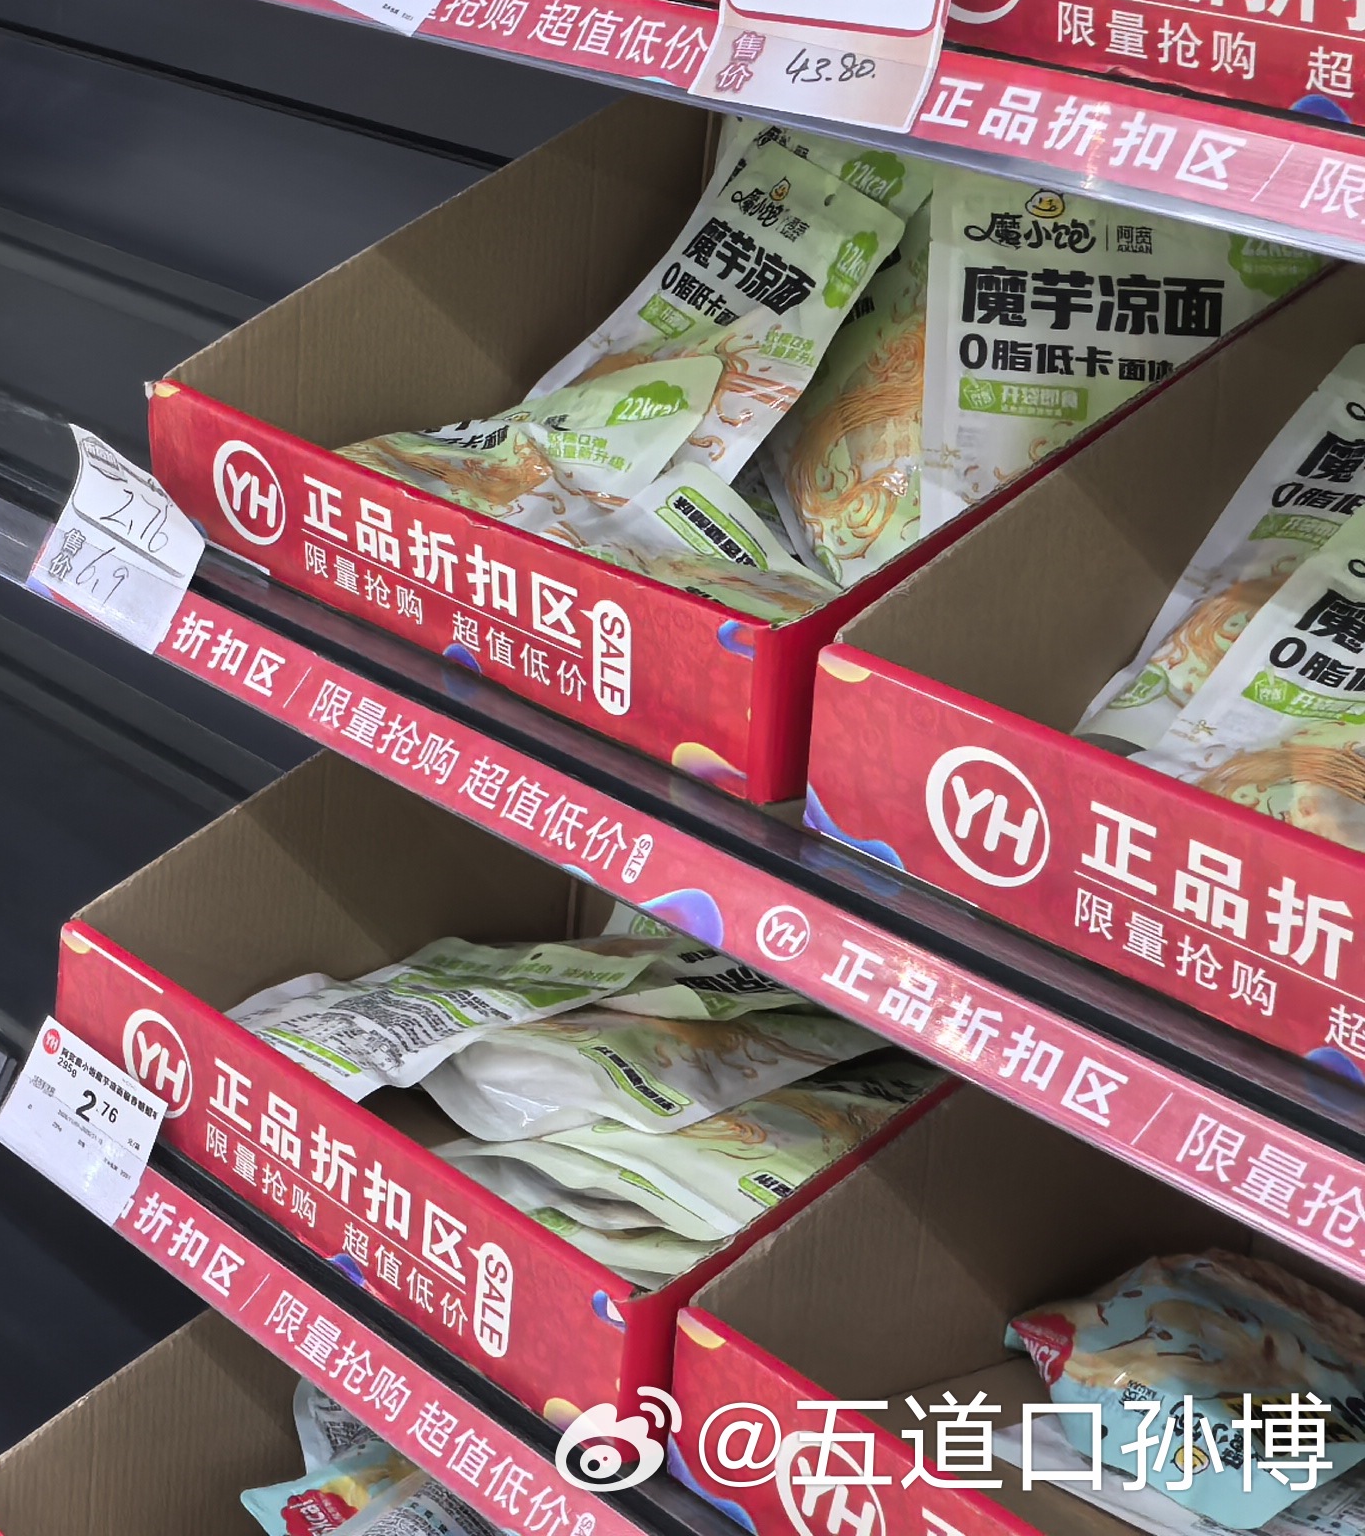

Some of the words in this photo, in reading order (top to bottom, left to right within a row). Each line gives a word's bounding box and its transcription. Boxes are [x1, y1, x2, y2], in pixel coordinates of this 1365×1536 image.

[528, 0, 708, 73] 超值低价
[715, 30, 768, 93] 售价
[1057, 1, 1257, 81] 限量抢购
[1306, 44, 1355, 101] 超
[921, 76, 1247, 193] 正品折扣区
[682, 217, 816, 316] 魔芋凉面
[1117, 225, 1153, 243] 阿宽
[961, 265, 1225, 338] 魔芋凉面
[960, 333, 1114, 378] 0脂低卡
[226, 463, 278, 528] YH
[51, 528, 86, 583] 售价
[303, 473, 582, 649] 正品折扣区
[303, 541, 424, 626] 限量抢购
[453, 611, 587, 703] 超值低价
[598, 610, 627, 707] SALE
[310, 680, 460, 784] 限量抢购
[460, 757, 626, 870] 超值低价
[626, 836, 651, 882] SALE
[952, 776, 1039, 865] YH
[766, 921, 805, 955] YH
[1081, 801, 1354, 979] 正品折
[1076, 889, 1275, 1017] 限量抢购
[57, 1056, 77, 1078] 295g
[134, 1031, 186, 1104] YH
[823, 940, 1129, 1127] 正品折扣区
[75, 1089, 119, 1124] 2.76
[211, 1059, 467, 1285] 正品折扣区
[206, 1124, 317, 1228] 限量抢购
[344, 1221, 468, 1336] 超值低价
[476, 1251, 507, 1351] SALE
[265, 1291, 410, 1422] 限量抢购
[407, 1400, 571, 1533] 超值低价
